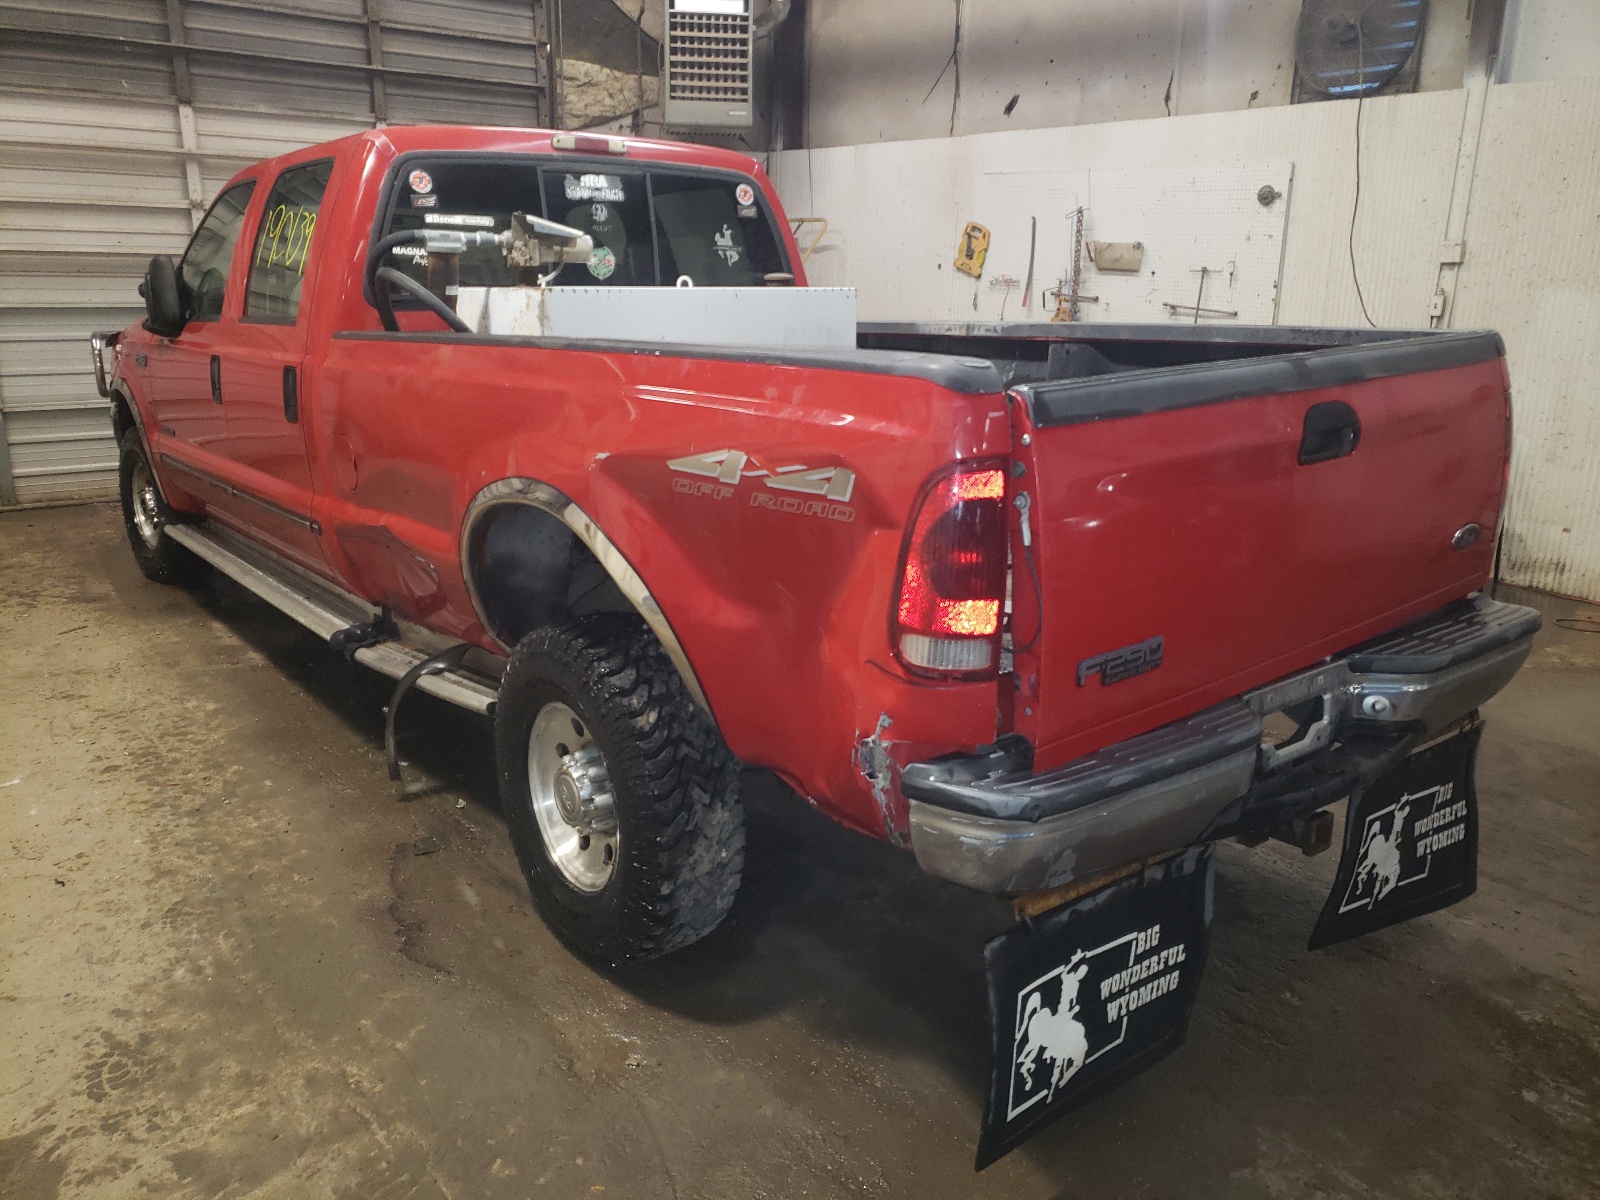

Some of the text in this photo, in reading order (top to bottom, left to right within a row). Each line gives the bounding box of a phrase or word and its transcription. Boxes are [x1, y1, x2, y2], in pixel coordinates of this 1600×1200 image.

[580, 173, 608, 188] NRA
[433, 214, 464, 225] Benelli
[392, 246, 428, 256] MAGNA
[672, 477, 855, 523] OFF ROAD
[1437, 782, 1453, 804] BIG
[1414, 800, 1468, 838] WONDERFUL
[1417, 823, 1465, 858] WYOMING
[1136, 923, 1160, 955] BIG
[1100, 943, 1186, 1000] WONDERFUL
[1107, 969, 1179, 1023] WYOMING
